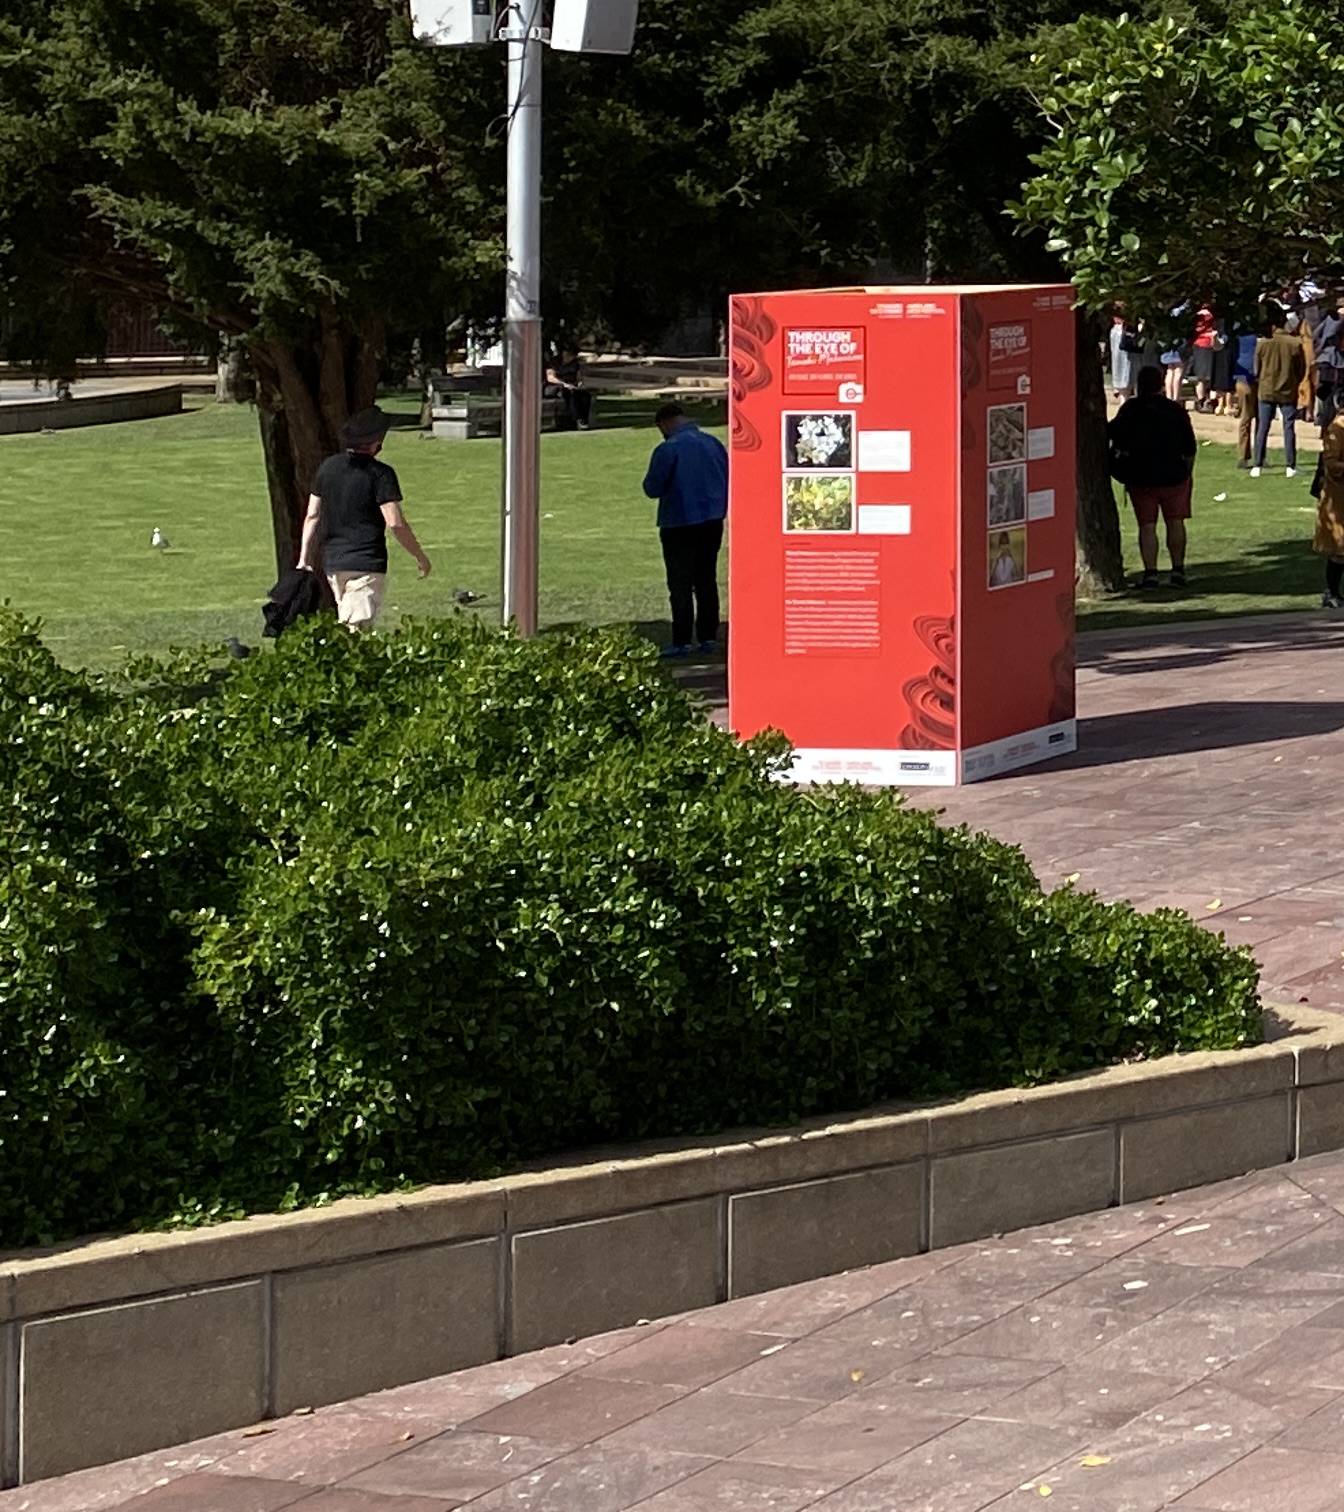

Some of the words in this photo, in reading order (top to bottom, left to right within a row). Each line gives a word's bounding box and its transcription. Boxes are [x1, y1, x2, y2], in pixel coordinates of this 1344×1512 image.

[787, 330, 851, 343] THROUGH
[787, 342, 813, 355] THE
[814, 342, 838, 355] EYE
[839, 341, 857, 355] OF
